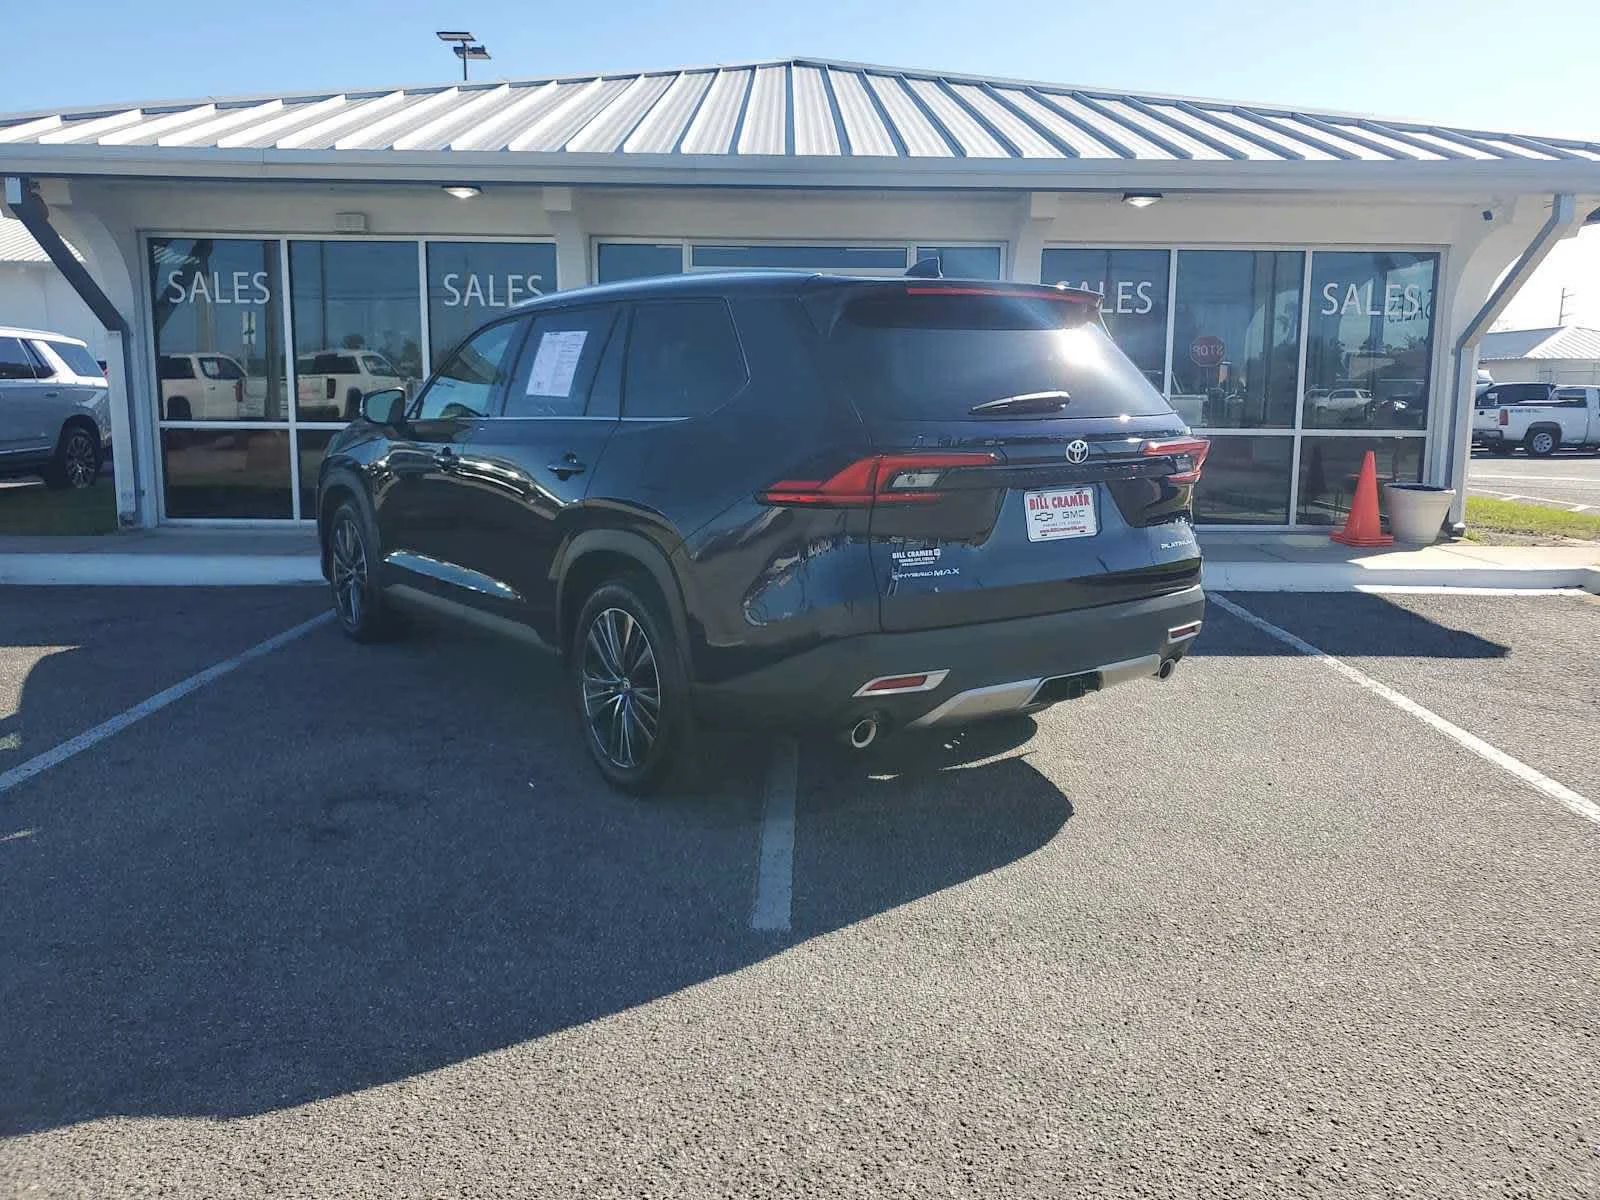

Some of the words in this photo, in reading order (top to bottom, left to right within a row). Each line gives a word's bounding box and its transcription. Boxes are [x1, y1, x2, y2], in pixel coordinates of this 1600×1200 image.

[168, 270, 271, 304] SALES
[443, 273, 543, 308] SALES
[1321, 282, 1420, 316] SALES
[1029, 496, 1049, 510] BILL
[1051, 494, 1090, 509] CRAMER
[1062, 509, 1086, 519] GMC
[892, 551, 906, 559] BILL
[907, 549, 934, 558] CRAMER
[933, 568, 960, 577] MAX
